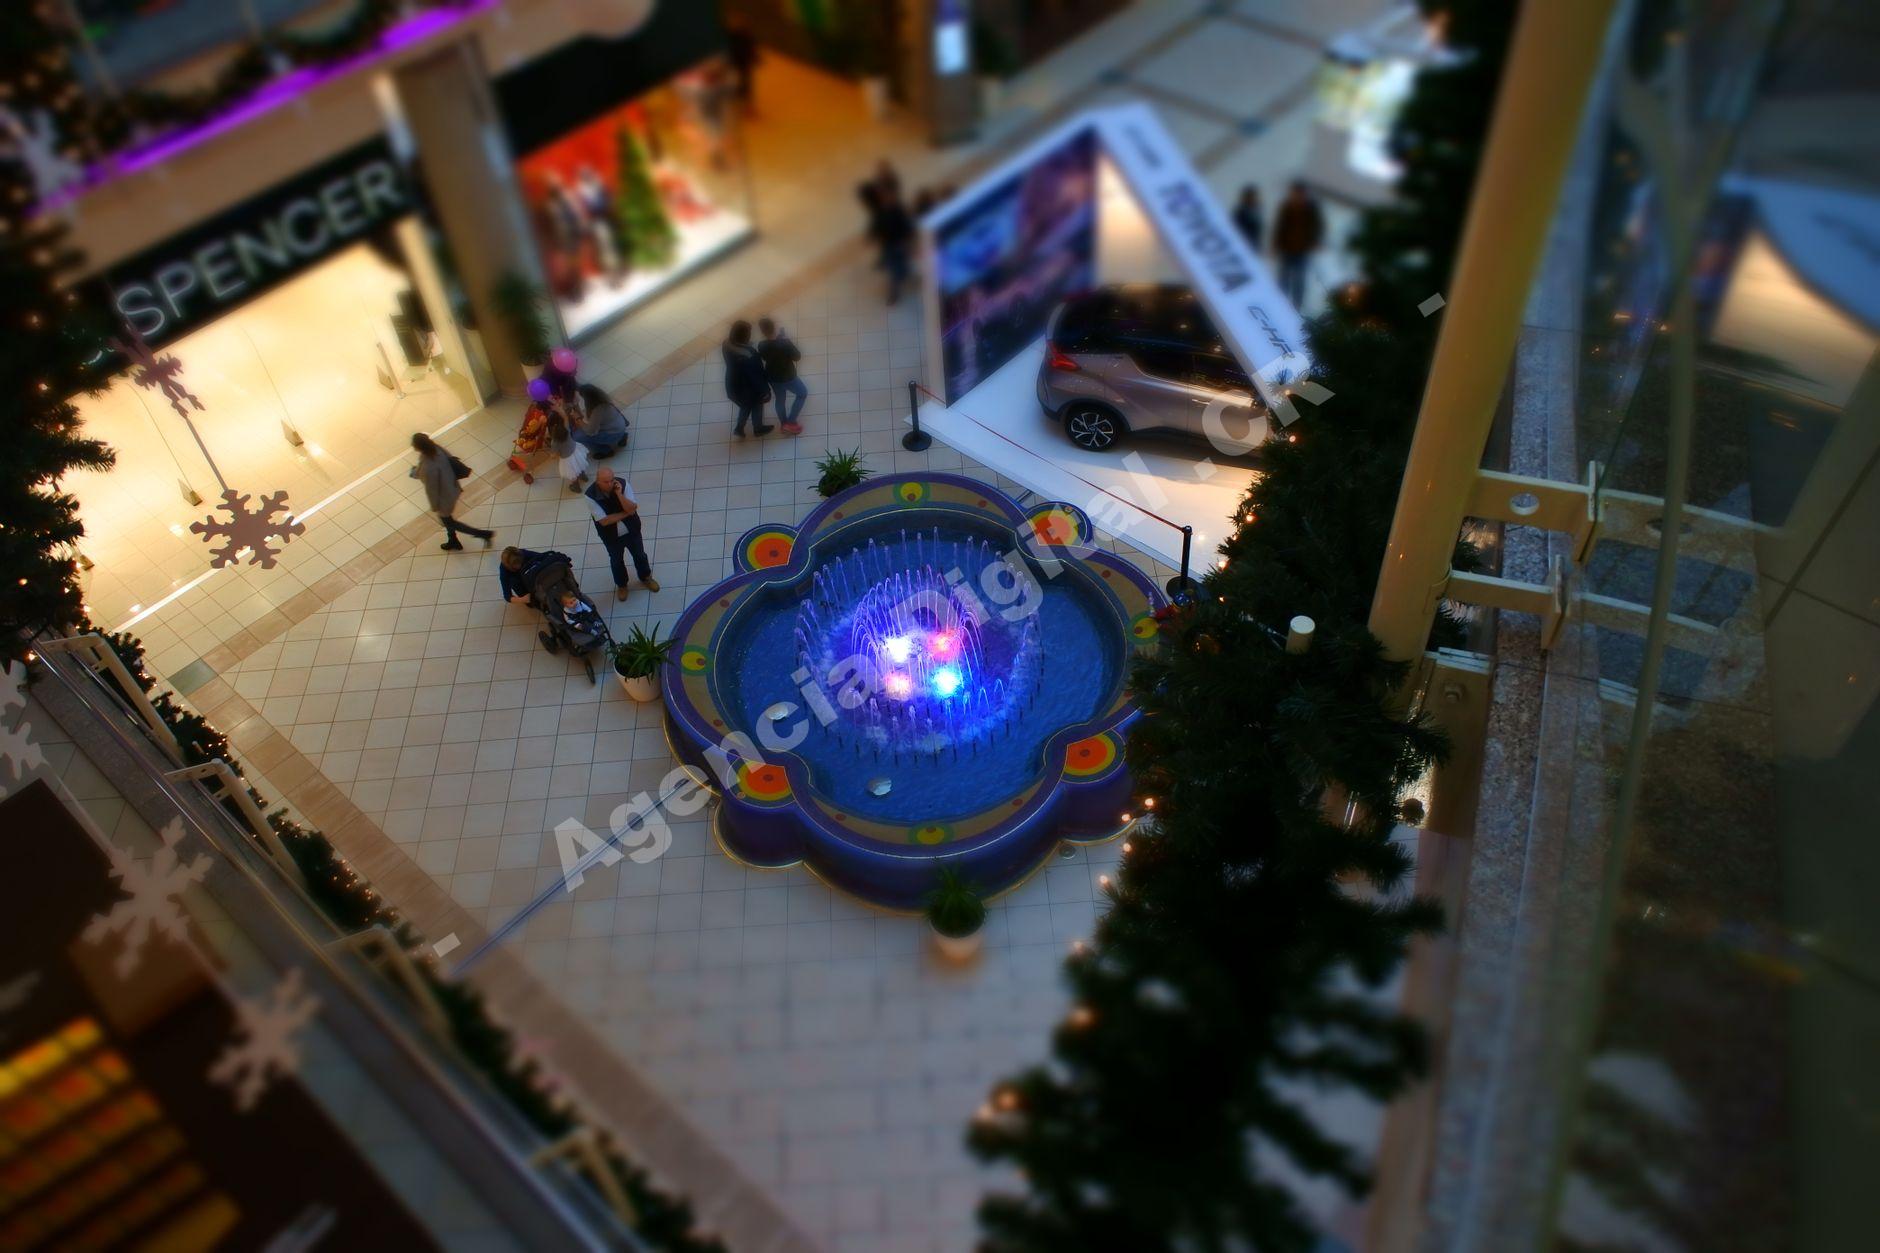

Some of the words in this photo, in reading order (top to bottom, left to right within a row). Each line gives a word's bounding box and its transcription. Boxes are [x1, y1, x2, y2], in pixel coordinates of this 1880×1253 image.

[116, 162, 403, 336] SPENCER
[1157, 181, 1254, 292] TOYOTA
[1247, 305, 1296, 359] C-HR
